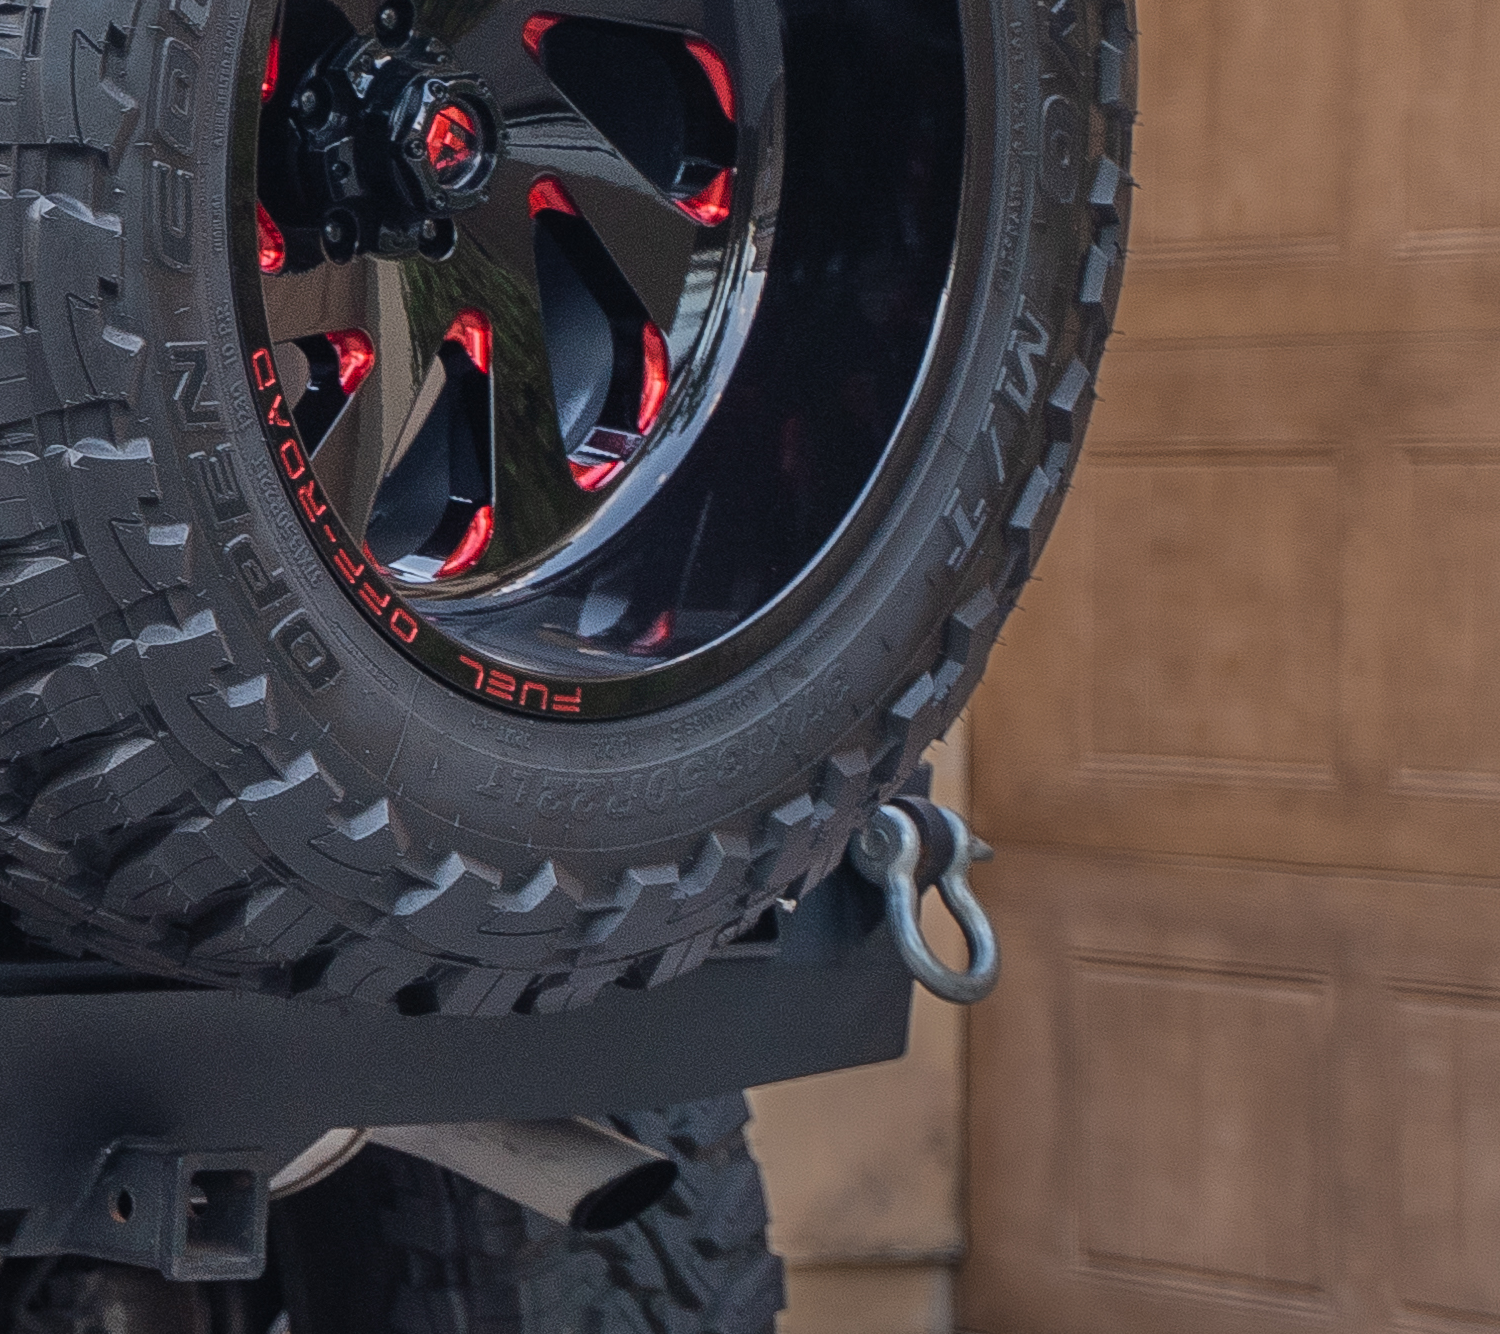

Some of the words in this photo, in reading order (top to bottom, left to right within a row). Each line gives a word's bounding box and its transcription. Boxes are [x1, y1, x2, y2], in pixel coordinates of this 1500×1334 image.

[164, 339, 345, 695] OPEN
[250, 346, 419, 644] OFF-ROAD
[940, 293, 1053, 570] M/T
[457, 653, 583, 713] FUEL
